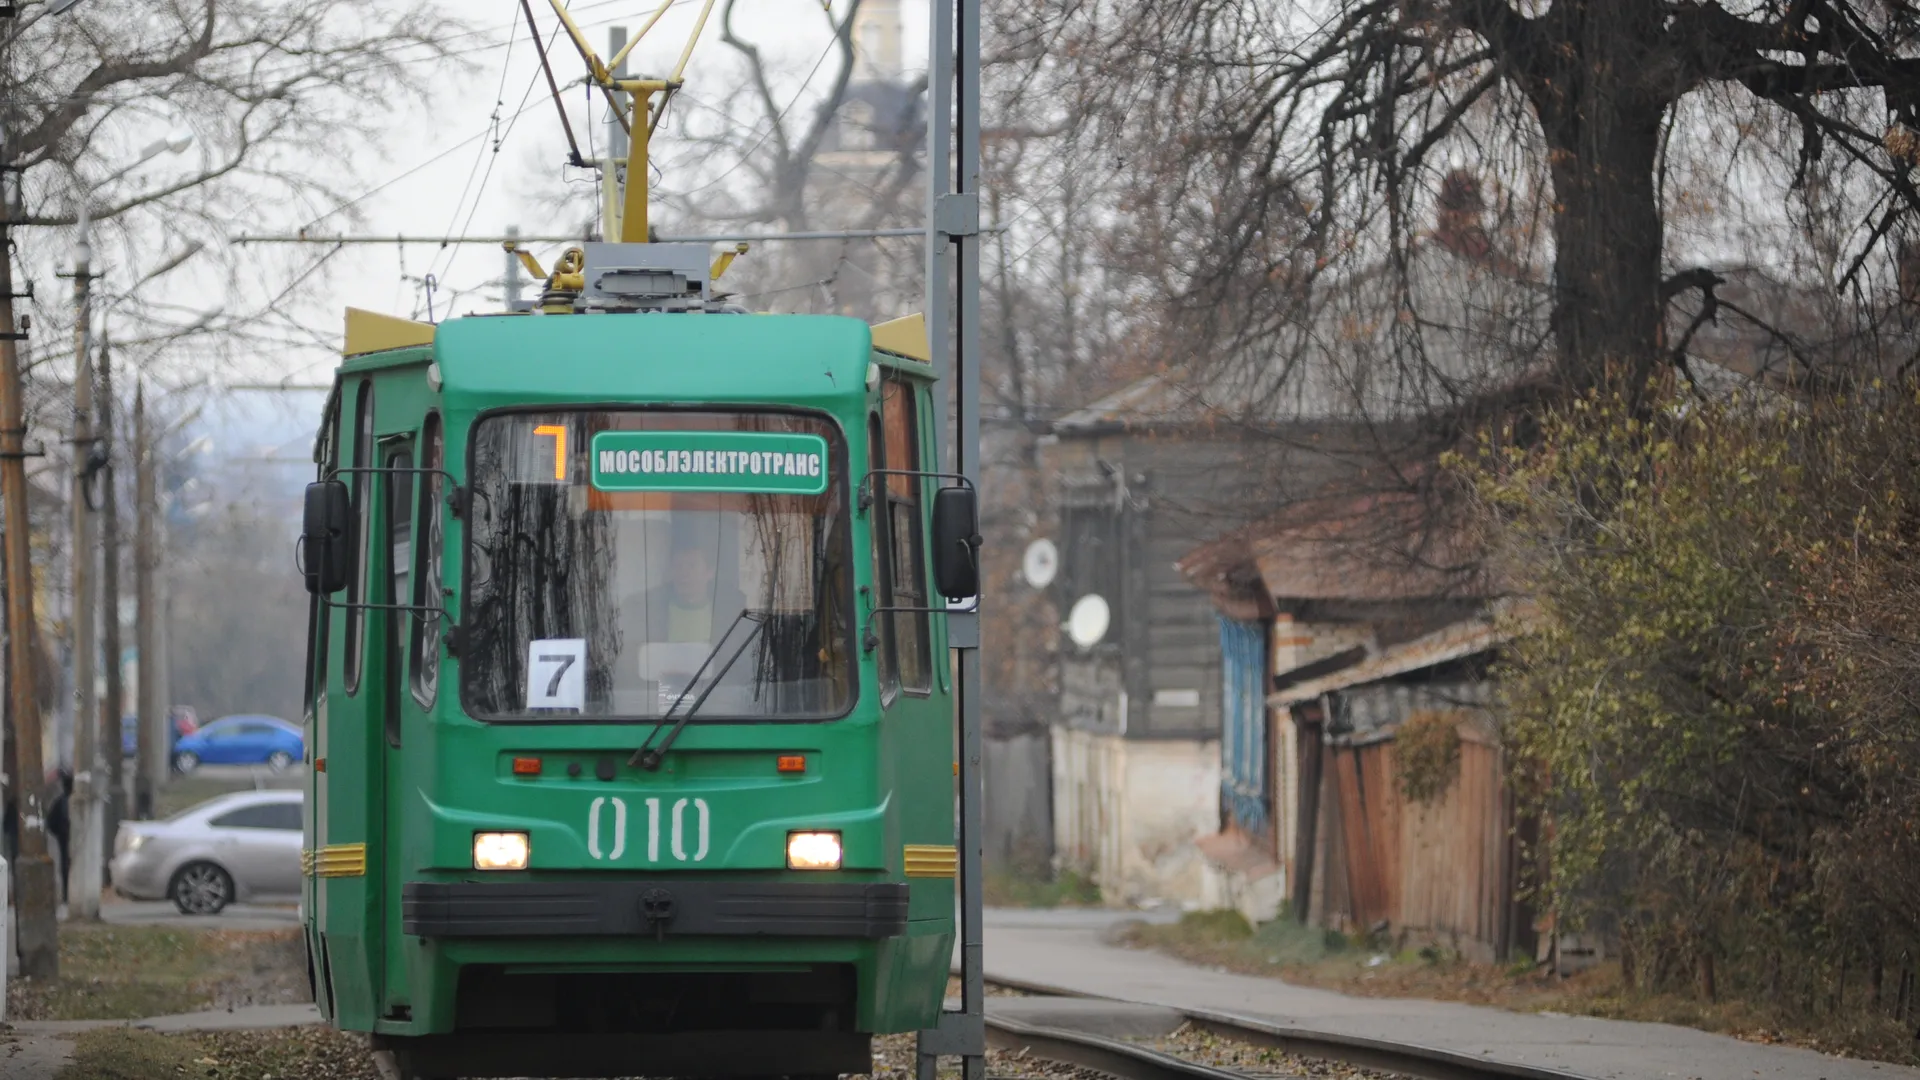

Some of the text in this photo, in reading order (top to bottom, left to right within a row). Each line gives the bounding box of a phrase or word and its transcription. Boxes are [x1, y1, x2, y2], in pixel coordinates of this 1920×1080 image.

[600, 450, 819, 477] МОСОБЛЭЛЕКТРОТРАНС
[539, 654, 576, 697] 7
[588, 797, 709, 862] 010
